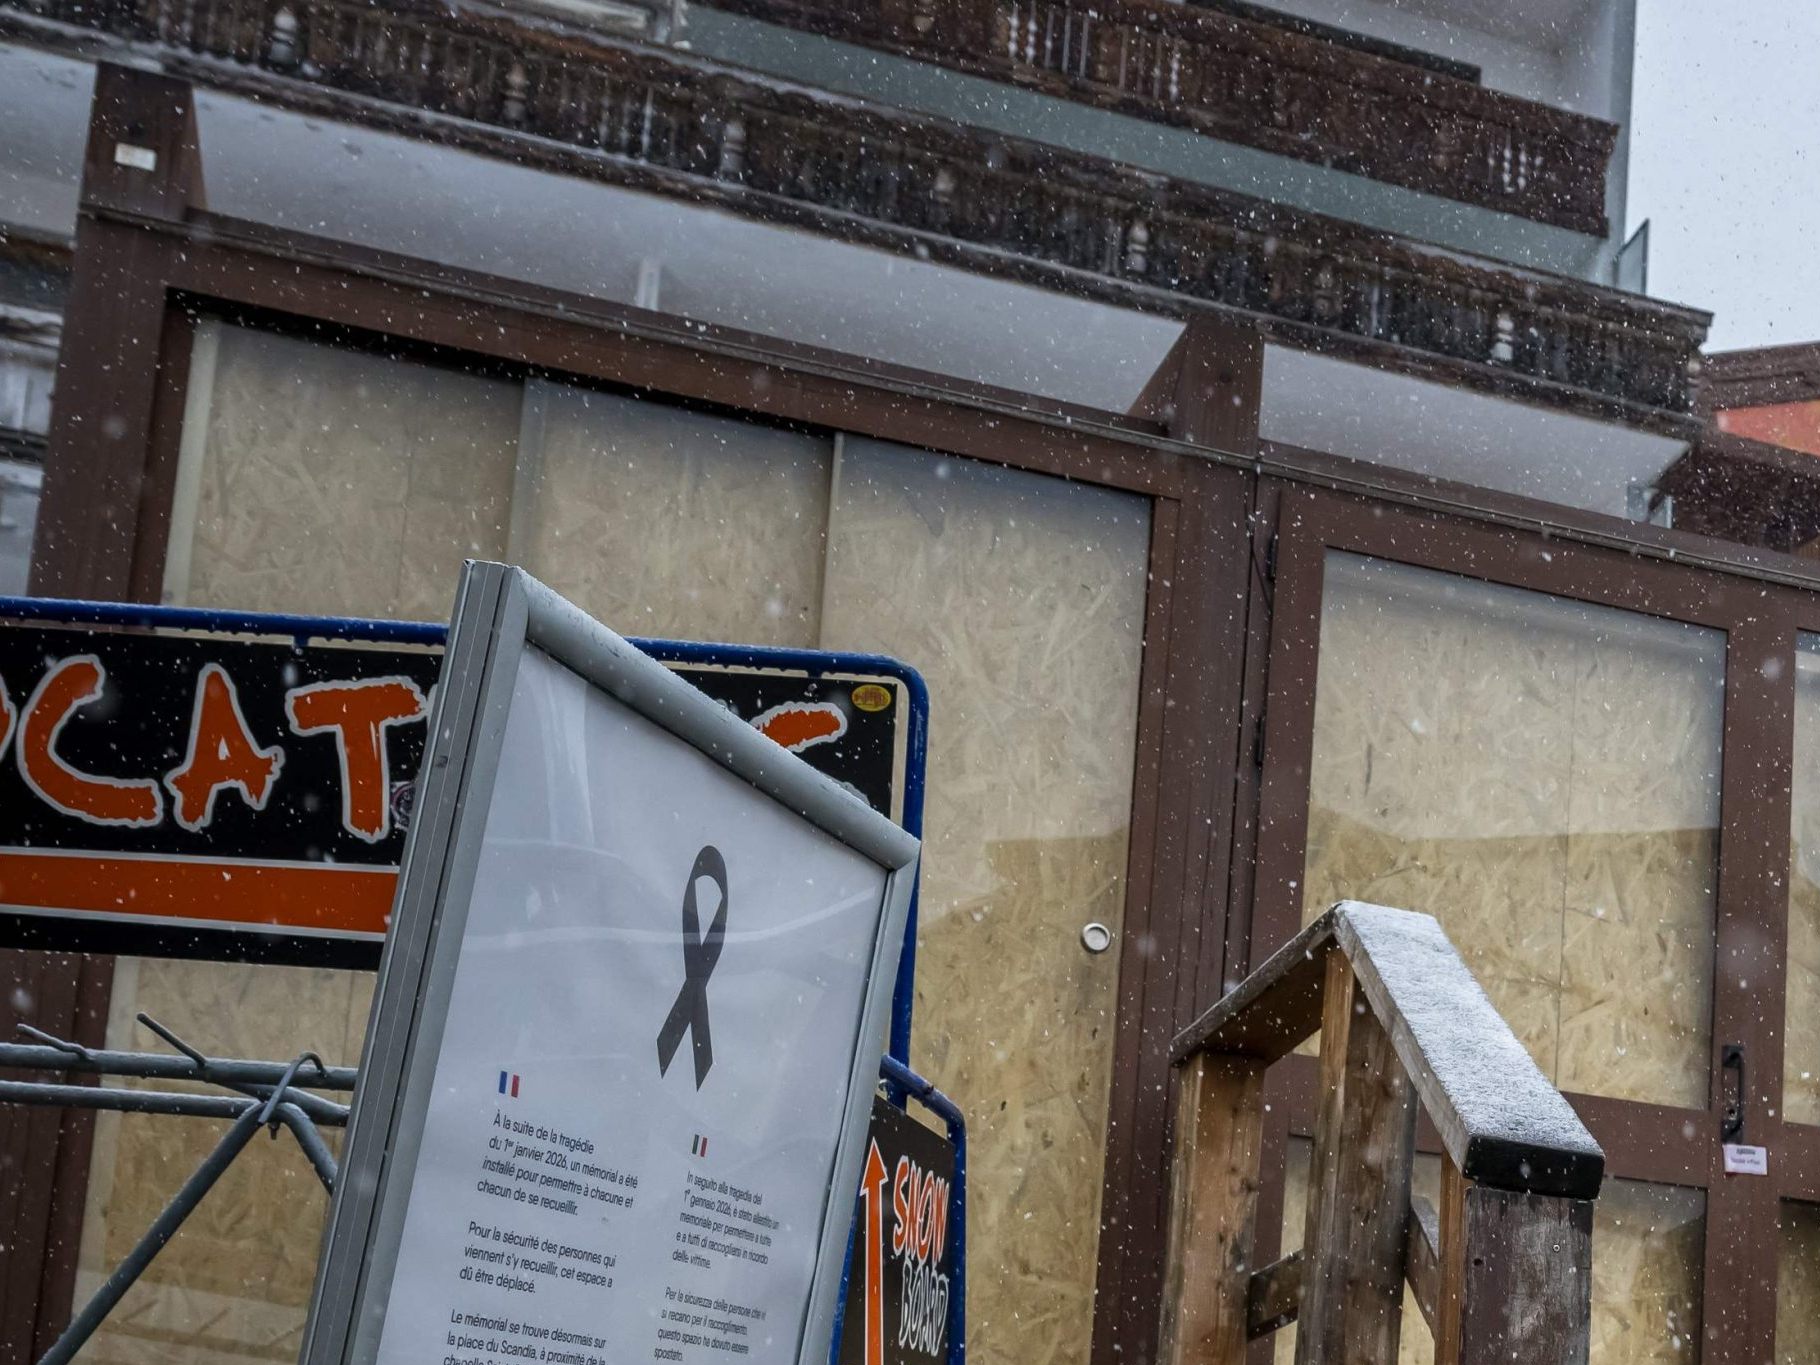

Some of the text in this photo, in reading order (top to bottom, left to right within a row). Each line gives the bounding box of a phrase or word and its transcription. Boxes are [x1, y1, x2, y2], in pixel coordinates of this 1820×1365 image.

[503, 1114, 511, 1130] la
[513, 1121, 534, 1136] suite
[536, 1126, 548, 1140] de
[550, 1128, 557, 1143] la
[559, 1133, 594, 1154] tragédie
[483, 1156, 634, 1208] installé pour permettre à chacune et
[489, 1136, 502, 1150] du
[514, 1142, 544, 1161] janvier
[570, 1161, 581, 1172] un
[582, 1164, 618, 1182] mémorial
[618, 1175, 624, 1184] a
[625, 1174, 638, 1188] été
[477, 1179, 511, 1198] chacun
[514, 1187, 526, 1202] de
[528, 1194, 539, 1205] se
[893, 1155, 949, 1265] SNOW
[468, 1221, 616, 1268] Pour la sécurité des personnes qui
[465, 1245, 504, 1263] viennent
[561, 1267, 575, 1279] cet
[576, 1271, 606, 1286] espace
[607, 1278, 613, 1288] a
[475, 1269, 494, 1284] être
[451, 1309, 606, 1348] Le mémorial se trouve désormais sur
[898, 1259, 949, 1357] BOARD
[447, 1331, 456, 1345] la
[457, 1334, 484, 1350] place
[486, 1338, 499, 1352] du
[540, 1347, 546, 1360] à
[546, 1351, 585, 1365] proximité
